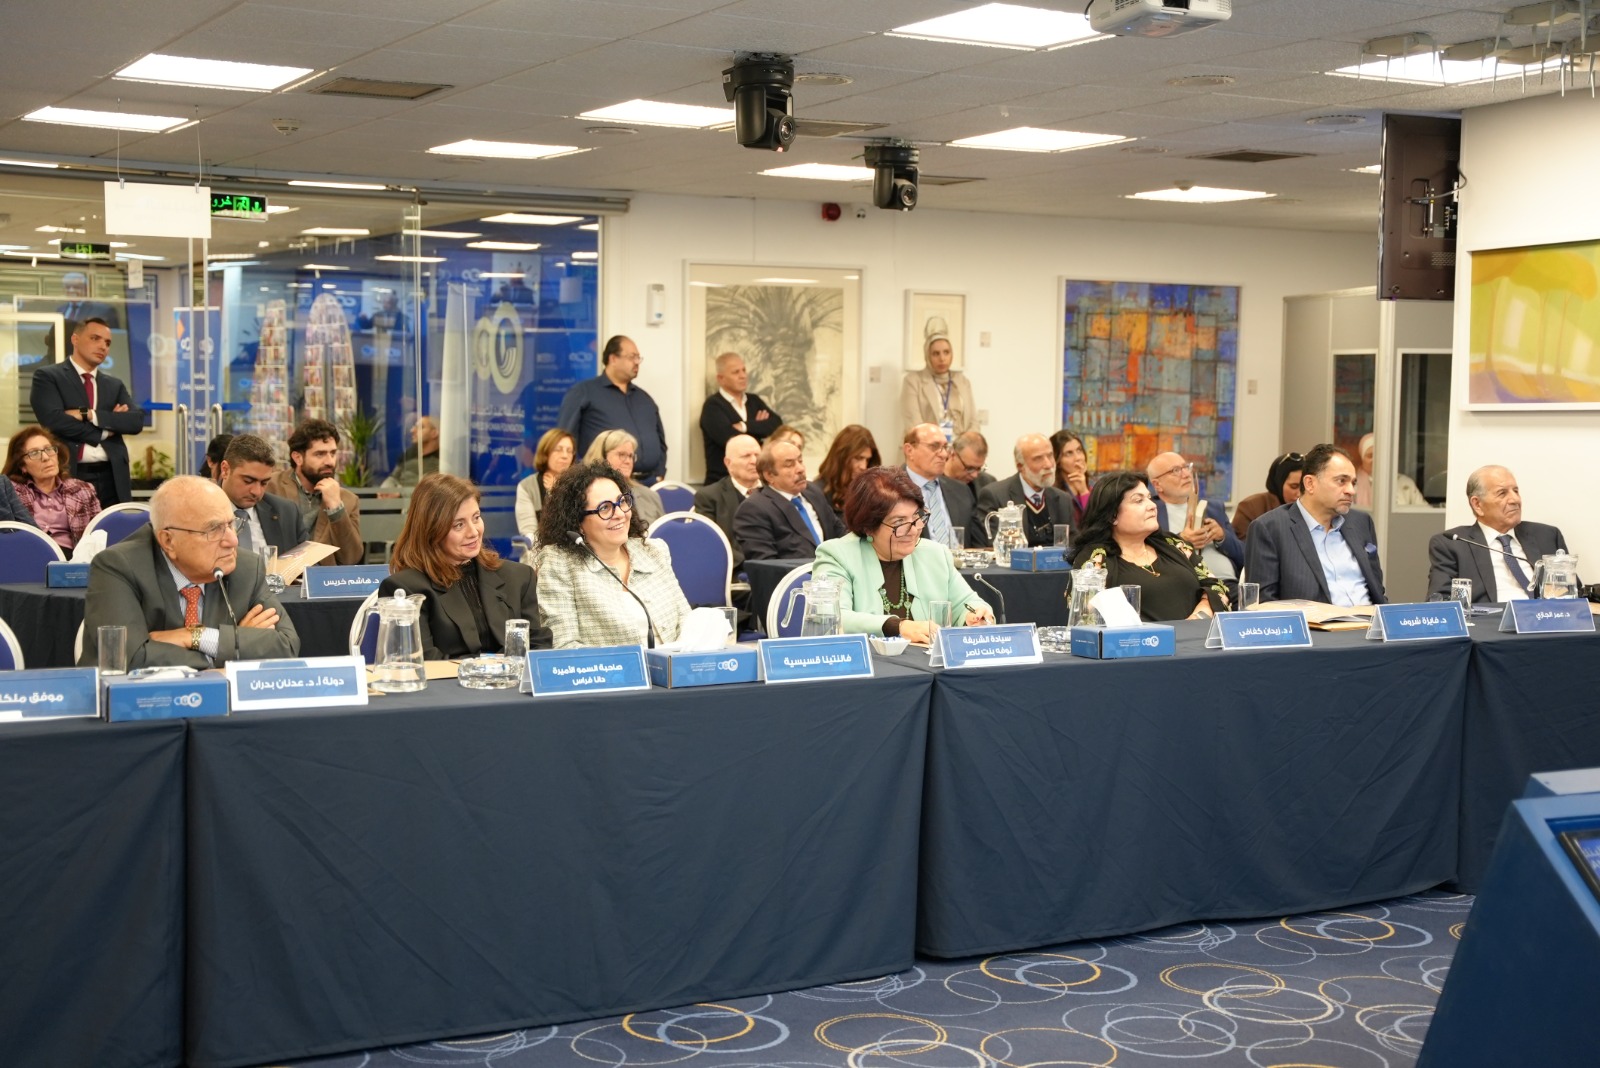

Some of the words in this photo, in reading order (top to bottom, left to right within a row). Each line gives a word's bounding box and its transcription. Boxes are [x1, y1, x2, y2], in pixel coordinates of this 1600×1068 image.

[348, 577, 371, 585] هاشم
[1422, 616, 1439, 626] فايزة
[1239, 627, 1263, 638] كفافي
[1264, 626, 1280, 636] زيدان
[963, 635, 989, 645] الشريفة
[966, 649, 980, 657] ناصر
[981, 648, 994, 656] بنت
[784, 656, 820, 667] قسيسية
[822, 654, 852, 665] فالنتينا
[553, 666, 575, 675] الأميرة
[577, 665, 598, 674] السمو
[599, 664, 623, 673] صاحبة
[250, 680, 274, 690] بدران
[276, 679, 303, 689] عدنان
[323, 676, 344, 686] دولة
[572, 677, 593, 686] فراس
[29, 692, 64, 703] موفق
